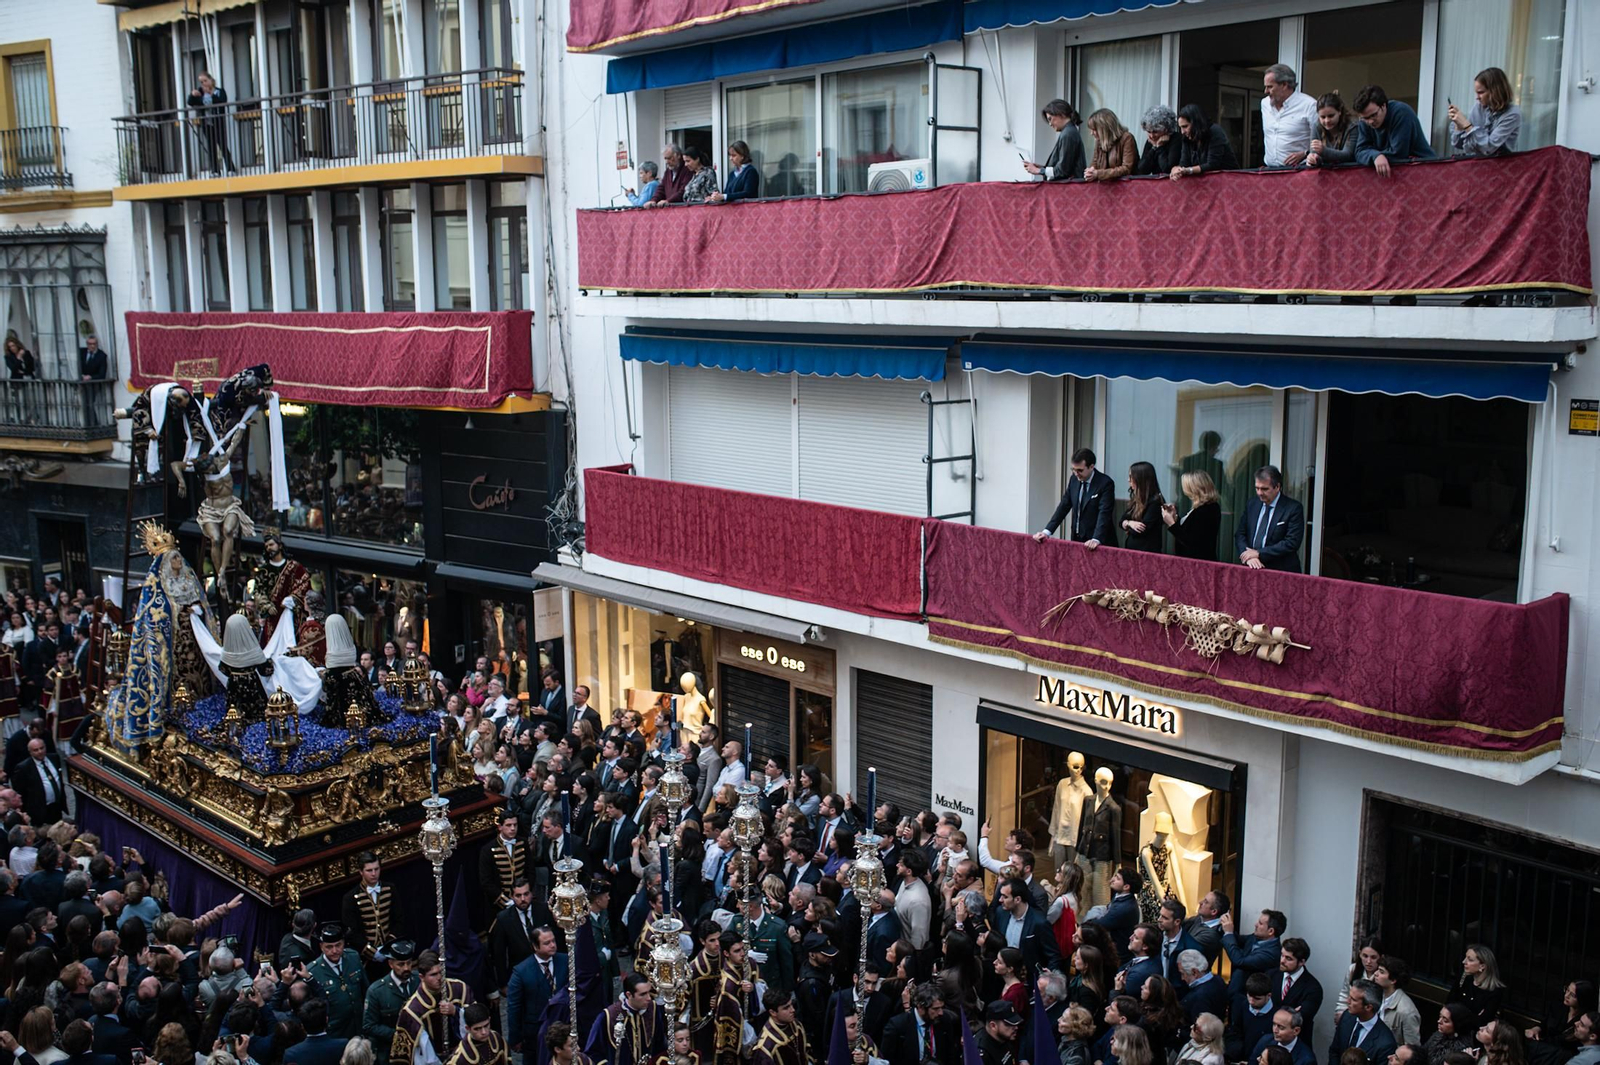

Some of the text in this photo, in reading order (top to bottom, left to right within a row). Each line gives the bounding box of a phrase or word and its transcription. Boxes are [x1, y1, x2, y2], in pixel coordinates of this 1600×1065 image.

[766, 646, 778, 665] O
[1035, 675, 1177, 734] MaxMara
[935, 793, 974, 816] MaxMara
